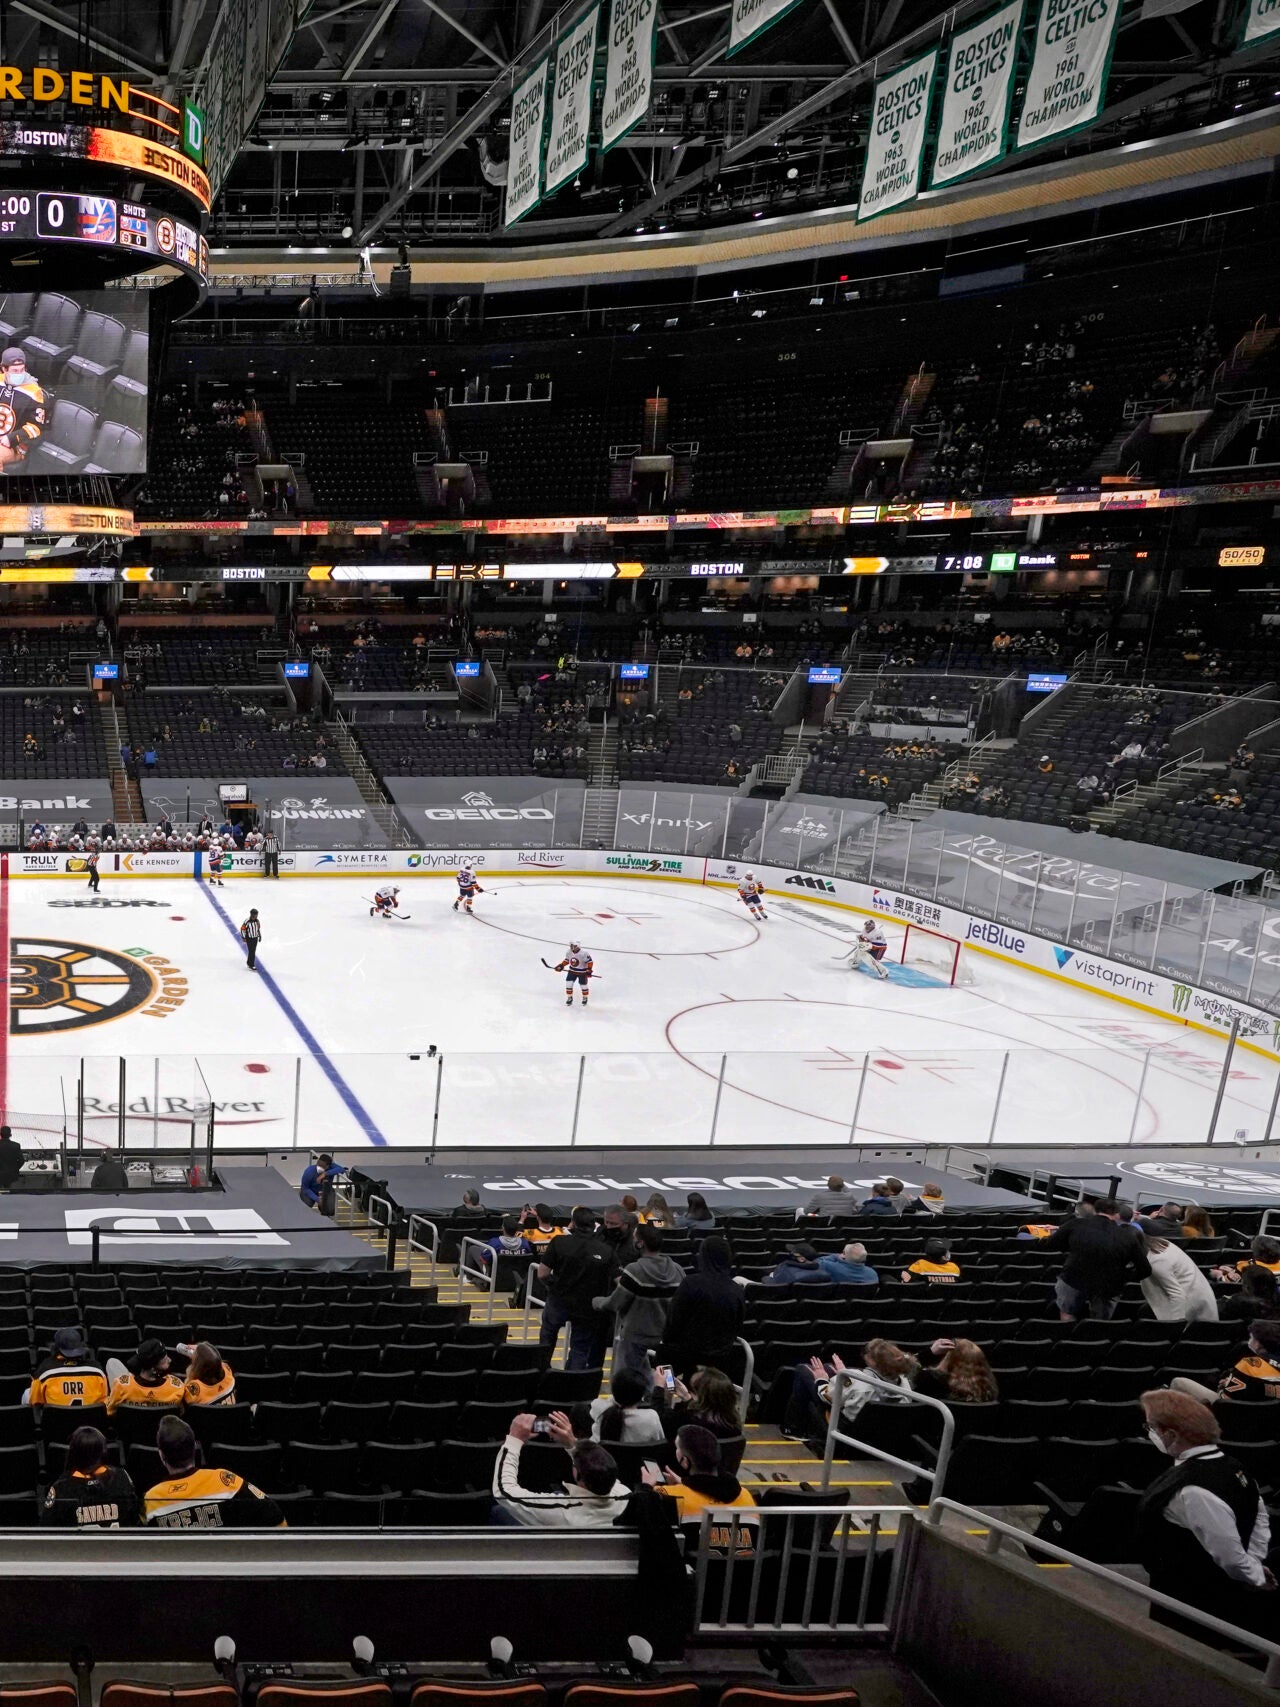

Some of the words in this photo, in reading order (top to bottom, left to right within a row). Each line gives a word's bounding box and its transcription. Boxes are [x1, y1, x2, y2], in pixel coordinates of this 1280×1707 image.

[614, 1, 652, 47] CELTICS
[1044, 0, 1108, 45] CELTICS
[558, 26, 594, 79] BOSTON
[954, 19, 1015, 72] BOSTON
[557, 54, 589, 100] CELTICS
[620, 57, 637, 79] 1968
[953, 47, 1007, 94] CELTICS
[1055, 53, 1079, 79] 1961
[614, 67, 640, 100] WORLD
[877, 71, 928, 117] BOSTON
[1043, 72, 1085, 104] WORLD
[514, 77, 544, 119] BOSTON
[605, 78, 647, 129] CHAMPIONS
[1025, 85, 1095, 129] CHAMPIONS
[514, 102, 540, 143] CELTICS
[876, 96, 922, 136] CELTICS
[963, 101, 985, 124] 1962
[14, 129, 68, 147] BOSTON
[186, 107, 202, 151] TD
[557, 121, 579, 146] WORLD
[953, 116, 989, 145] WORLD
[549, 133, 585, 174] CHAMPIONS
[883, 145, 904, 165] 1963
[938, 127, 998, 168] CHAMPIONS
[876, 158, 907, 184] WORLD
[863, 170, 915, 204] CHAMPIONS
[47, 199, 65, 228] 0
[123, 203, 146, 218] SHOTS
[135, 220, 142, 230] 0
[135, 235, 142, 245] 0
[944, 555, 983, 570] 7:08
[995, 557, 1014, 569] TD
[1019, 555, 1056, 566] Bank
[1223, 549, 1261, 559] 50/50
[222, 568, 265, 580] BOSTON
[690, 562, 745, 576] BOSTON
[424, 807, 555, 821] GEICO
[622, 812, 713, 831] xfinity
[23, 855, 59, 865] TRULY
[131, 859, 144, 867] LEE
[145, 858, 181, 867] KENNEDY
[337, 854, 388, 863] SYMETRA
[423, 853, 486, 868] dynatrace
[517, 852, 536, 863] Red
[538, 852, 565, 863] River
[606, 856, 649, 868] SULLIVAN
[662, 860, 683, 870] TIRE
[950, 834, 1022, 865] Red
[1023, 850, 1141, 892] River
[460, 873, 470, 884] 26
[893, 907, 906, 917] ORG
[965, 918, 1026, 954] jetBlue
[1075, 959, 1155, 996] vistaprint
[1167, 966, 1194, 982] CROSS
[143, 955, 190, 1019] GARDEN
[1214, 981, 1242, 998] CROSS
[1194, 993, 1270, 1034] MONSTER
[81, 1097, 160, 1114] Red
[167, 1097, 266, 1115] River
[62, 1381, 85, 1396] ORR
[76, 1504, 120, 1524] SAVARD
[156, 1503, 224, 1528] KREJCI
